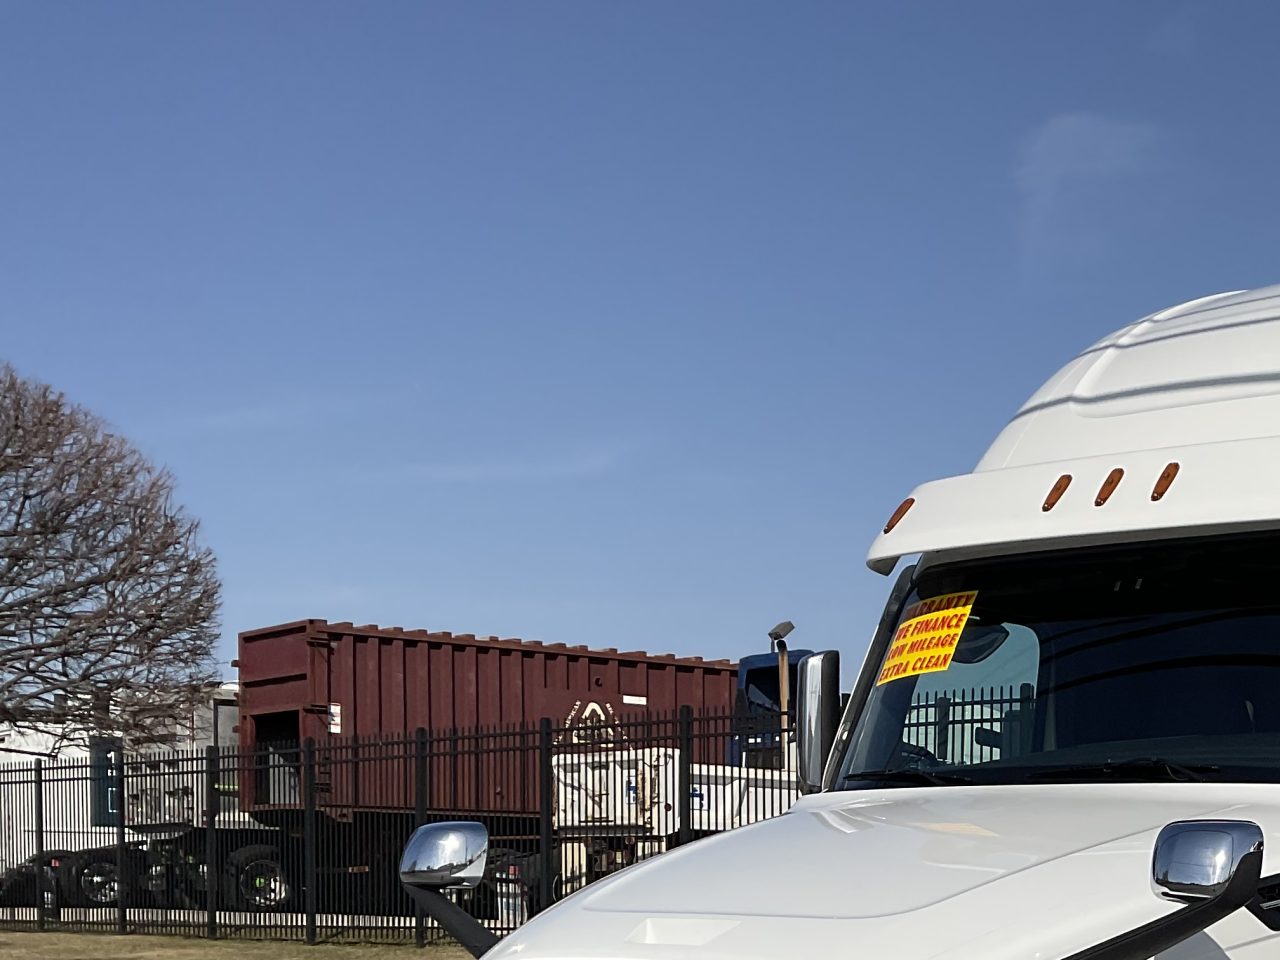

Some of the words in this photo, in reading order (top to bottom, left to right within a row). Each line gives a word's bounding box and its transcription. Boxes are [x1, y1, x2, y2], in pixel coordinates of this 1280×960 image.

[896, 624, 912, 642] WE
[911, 613, 967, 637] FINANCE
[887, 643, 908, 661] LOW
[907, 633, 959, 654] MILEAGE
[880, 660, 910, 681] EXTRA
[912, 653, 951, 672] CLEAN
